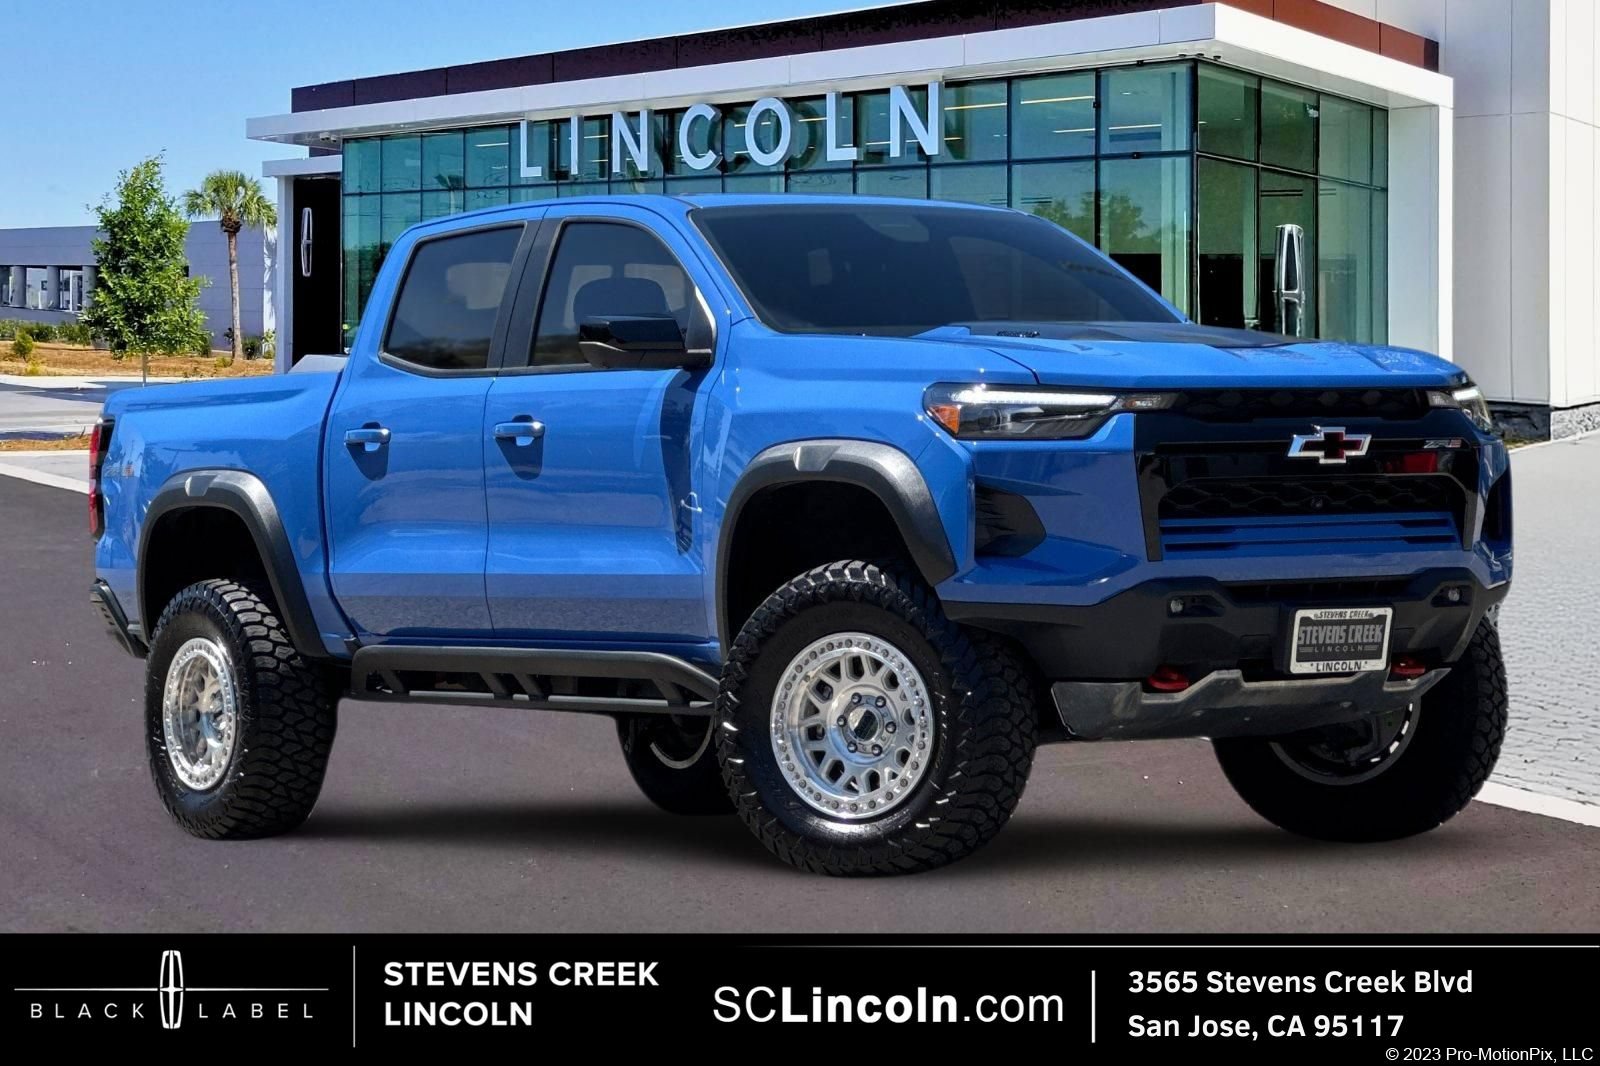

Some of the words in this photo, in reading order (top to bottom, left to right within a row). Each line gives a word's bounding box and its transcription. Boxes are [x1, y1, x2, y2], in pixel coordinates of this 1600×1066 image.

[520, 81, 943, 178] LINCOLN
[1319, 611, 1347, 619] STEVENS
[1297, 625, 1347, 644] STEVENS
[1348, 625, 1383, 643] CREEK
[1315, 645, 1363, 653] LINCOLN
[1316, 661, 1361, 672] LINCOLN
